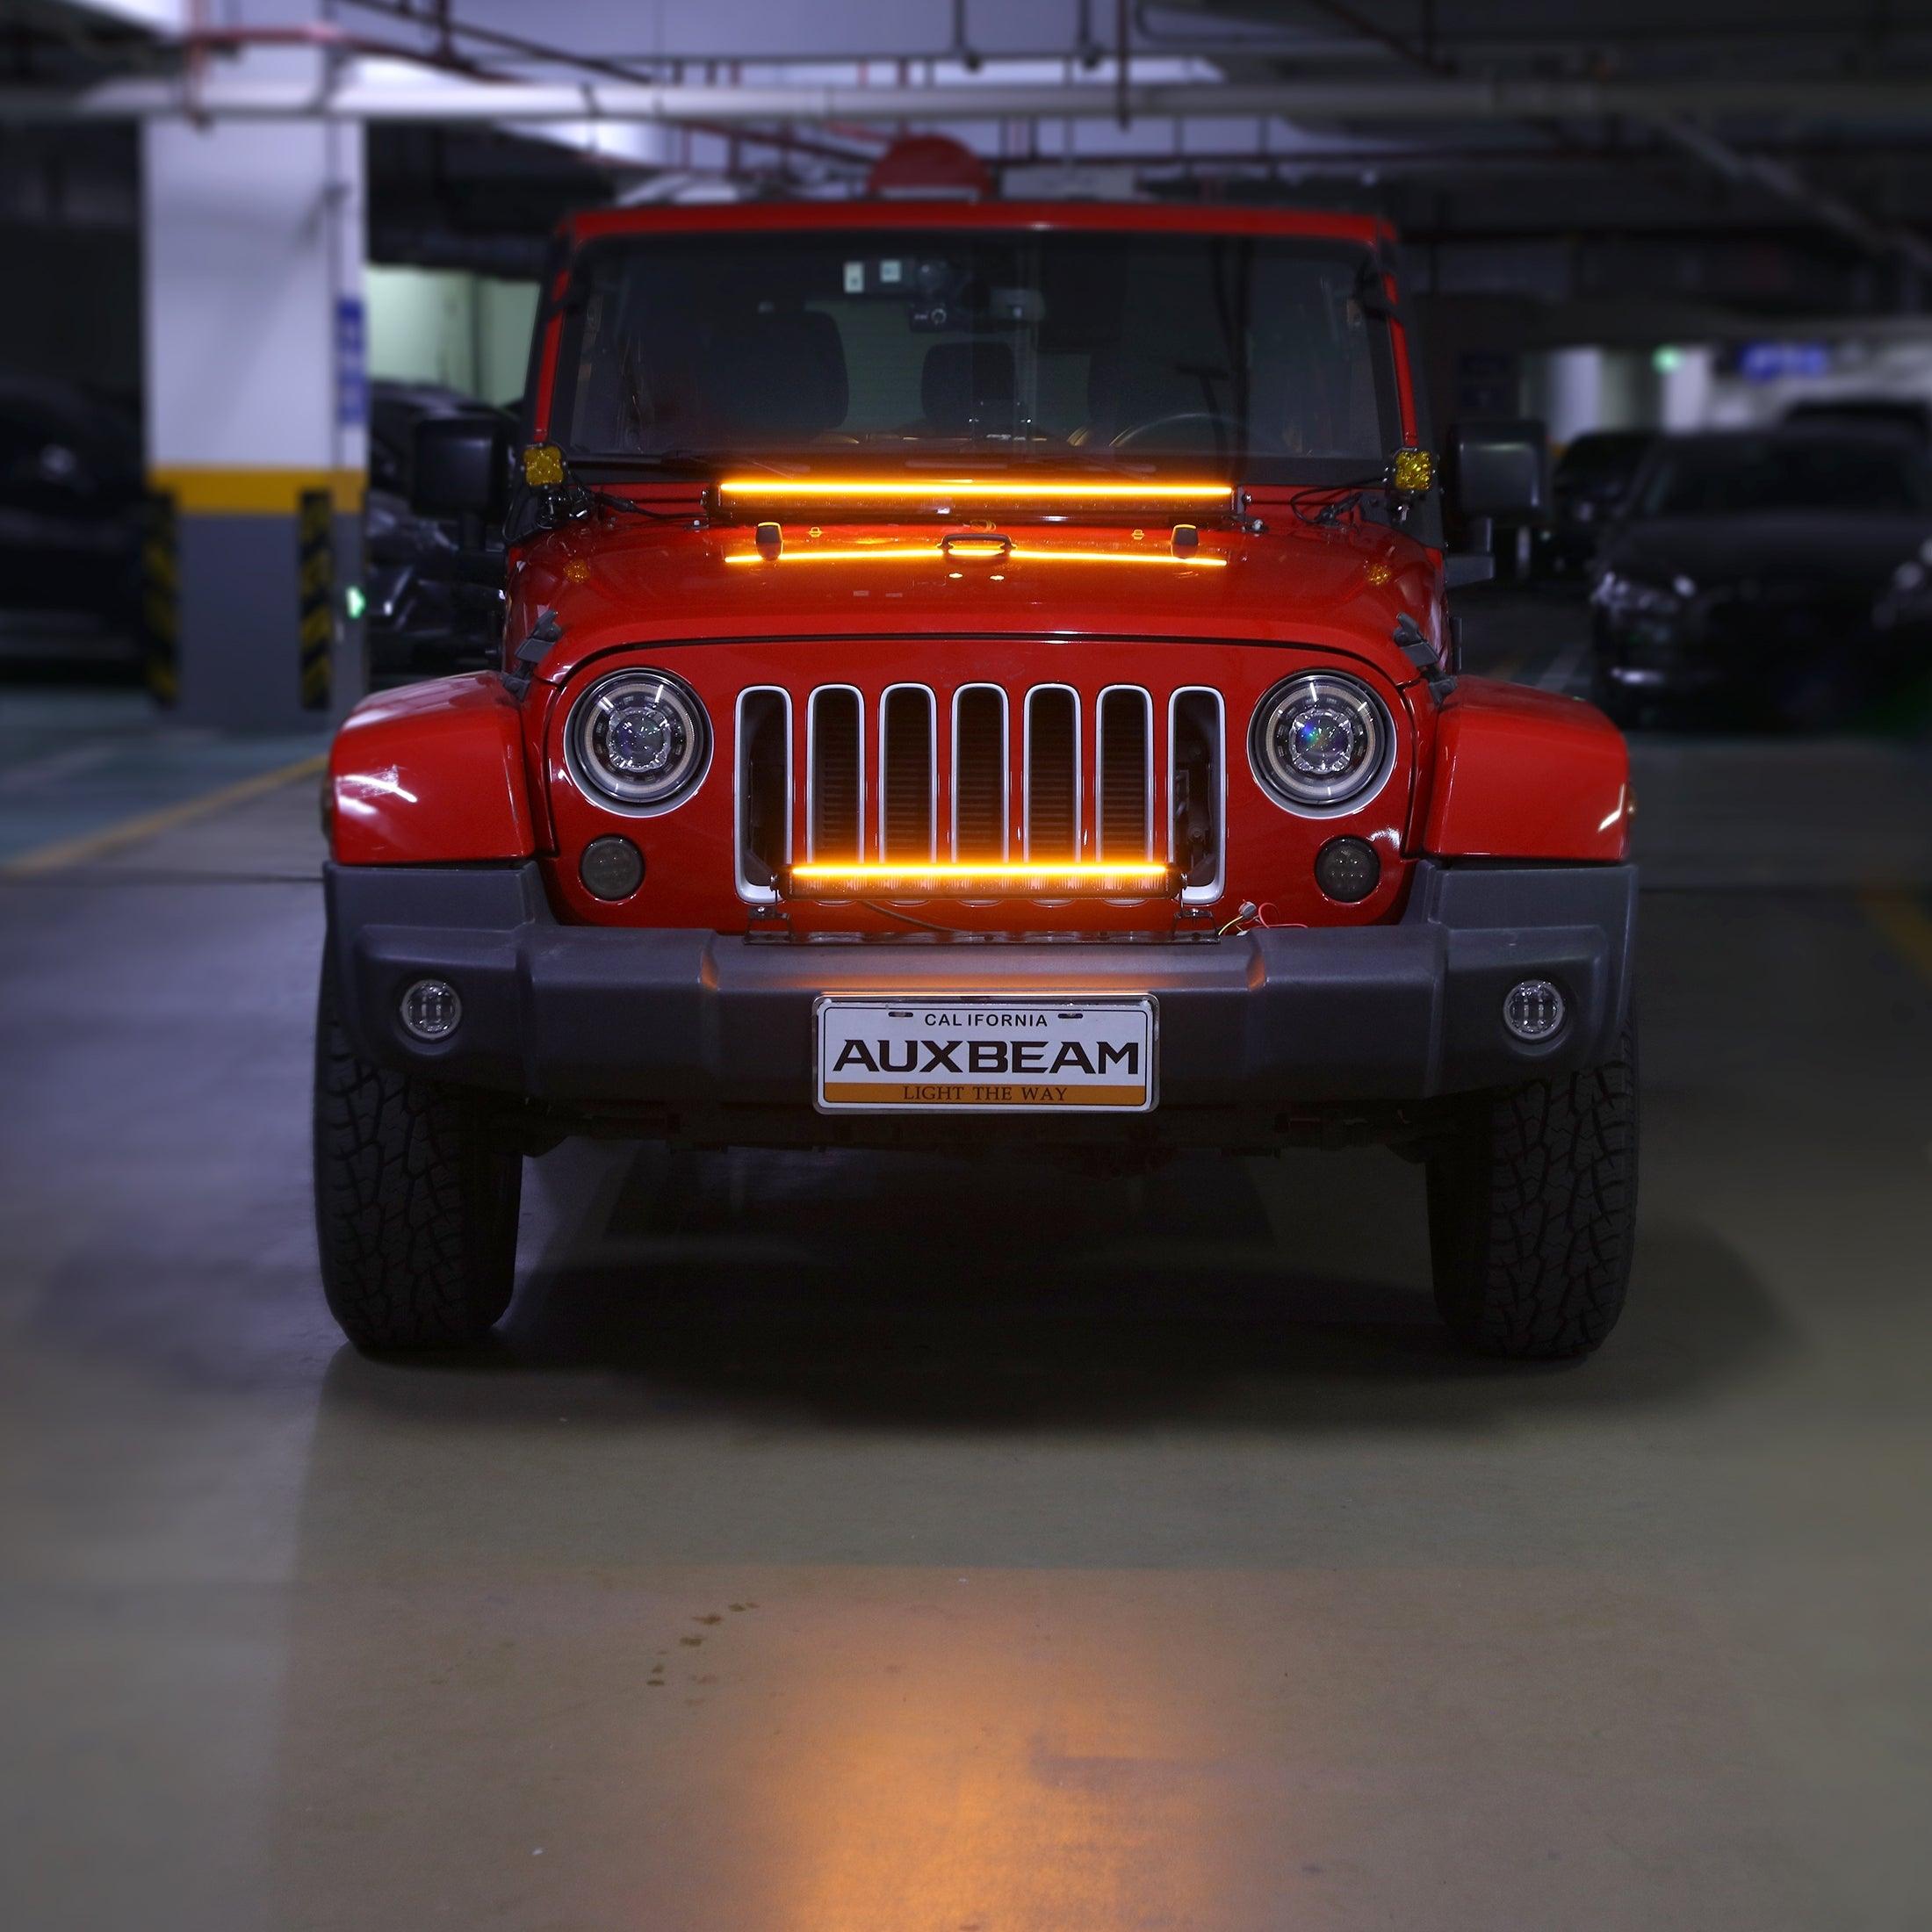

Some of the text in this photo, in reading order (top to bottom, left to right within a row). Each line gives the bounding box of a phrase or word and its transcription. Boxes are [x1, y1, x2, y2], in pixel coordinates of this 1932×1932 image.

[925, 1013, 1048, 1027] CALIFORNIA
[833, 1039, 1139, 1075] AUXBEAM
[904, 1085, 1068, 1102] LIGHT THE WAY
